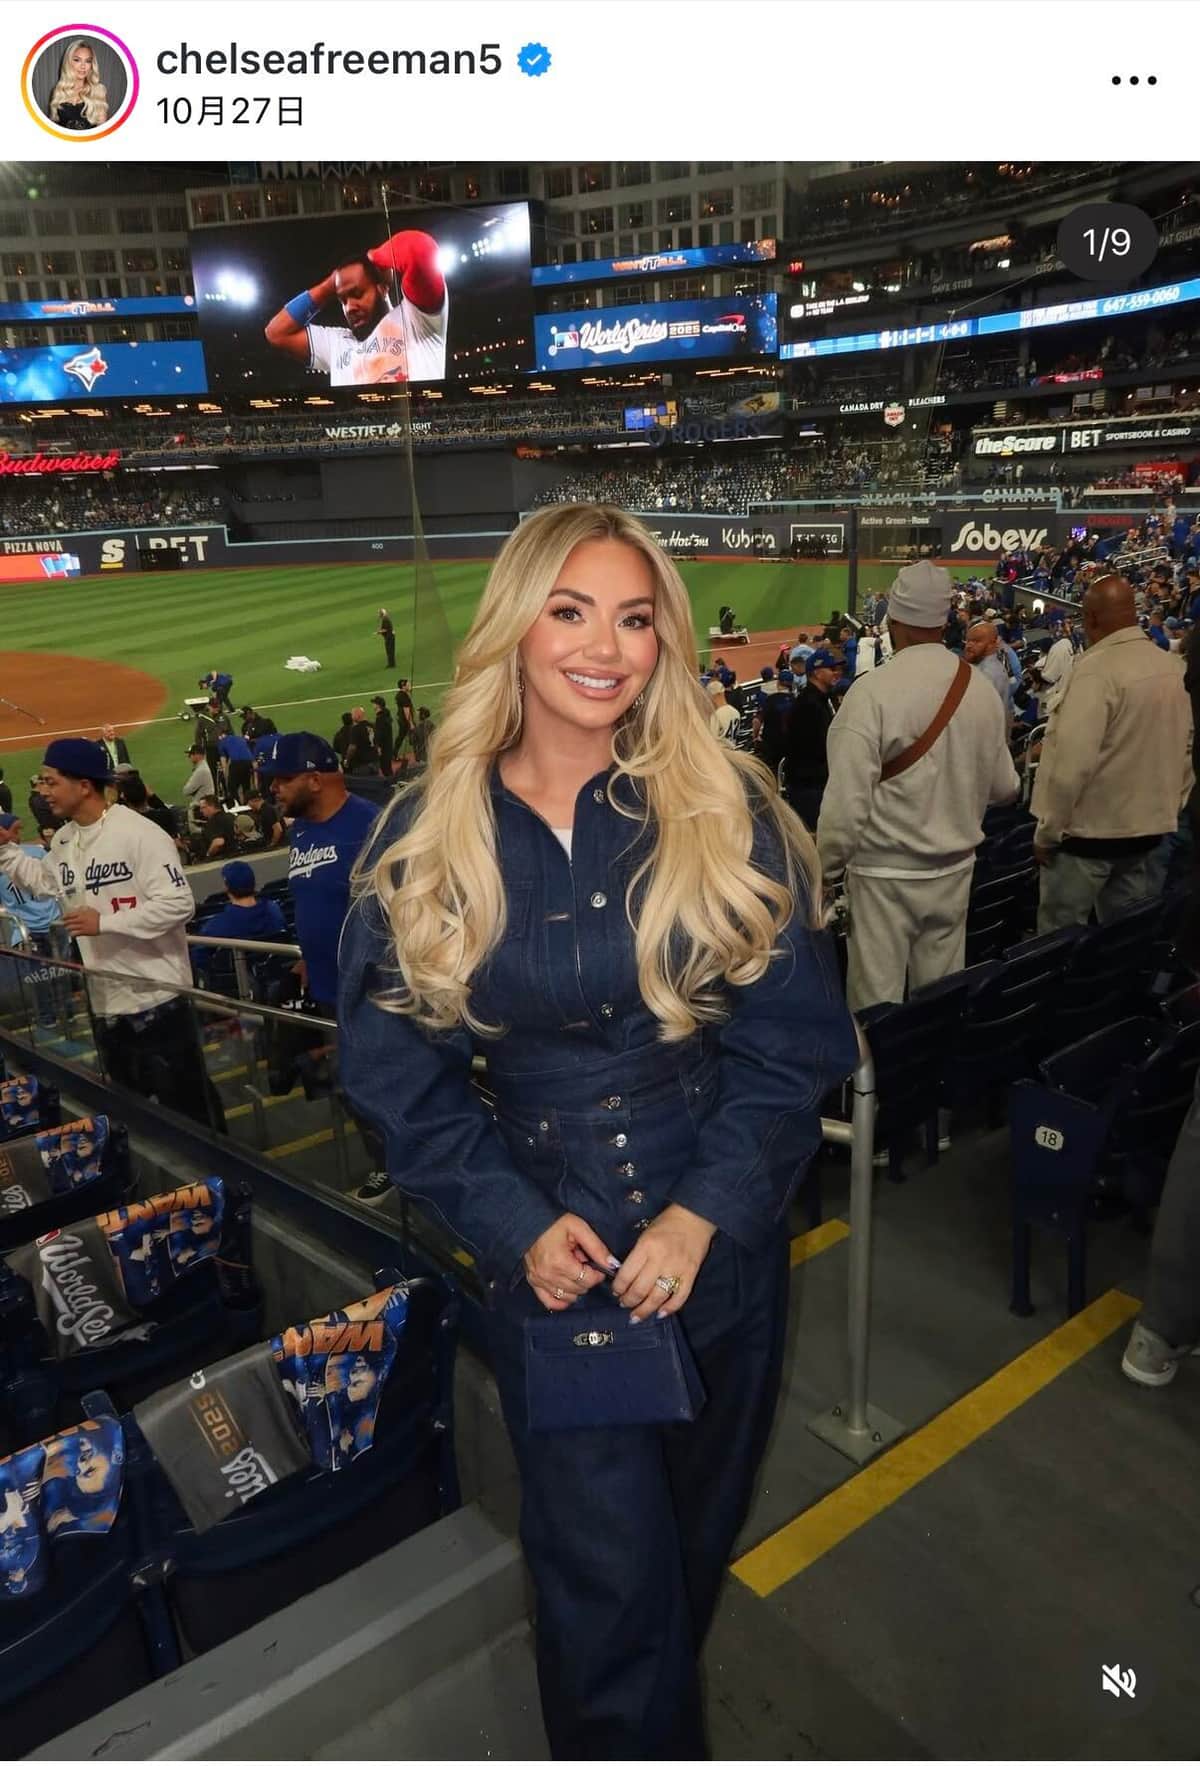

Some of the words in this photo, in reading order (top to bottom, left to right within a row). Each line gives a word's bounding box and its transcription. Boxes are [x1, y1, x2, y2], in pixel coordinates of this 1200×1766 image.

[669, 323, 700, 336] 2025
[840, 403, 868, 413] CANADA
[870, 401, 884, 411] DRY
[1071, 430, 1103, 448] BET
[1105, 430, 1153, 441] SPORTSBOOK
[1162, 428, 1191, 437] CASINO
[975, 435, 1056, 455] theScore
[951, 521, 1047, 552] Sobeys
[4, 542, 34, 554] PIZZA
[36, 540, 63, 552] NOVA
[101, 539, 125, 564] S
[288, 843, 338, 879] Dodgers
[1041, 1130, 1057, 1146] 18
